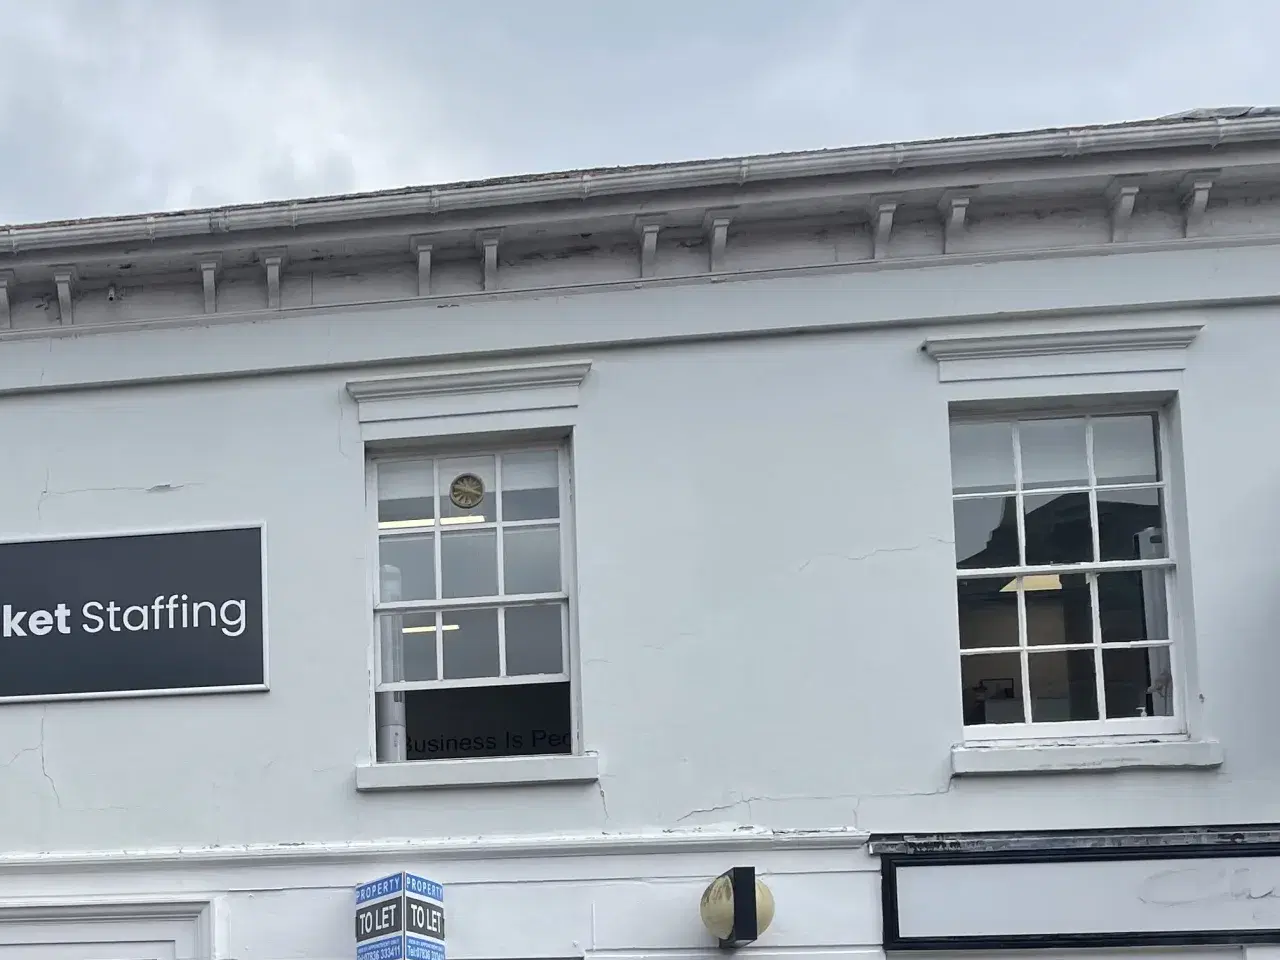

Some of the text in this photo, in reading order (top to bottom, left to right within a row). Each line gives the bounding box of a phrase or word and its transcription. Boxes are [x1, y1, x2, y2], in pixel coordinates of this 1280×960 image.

[82, 594, 247, 638] Staffing
[356, 876, 400, 900] PROPERTY
[406, 876, 443, 899] PROPERTY
[359, 904, 397, 935] TO LET
[410, 903, 441, 933] TO LET
